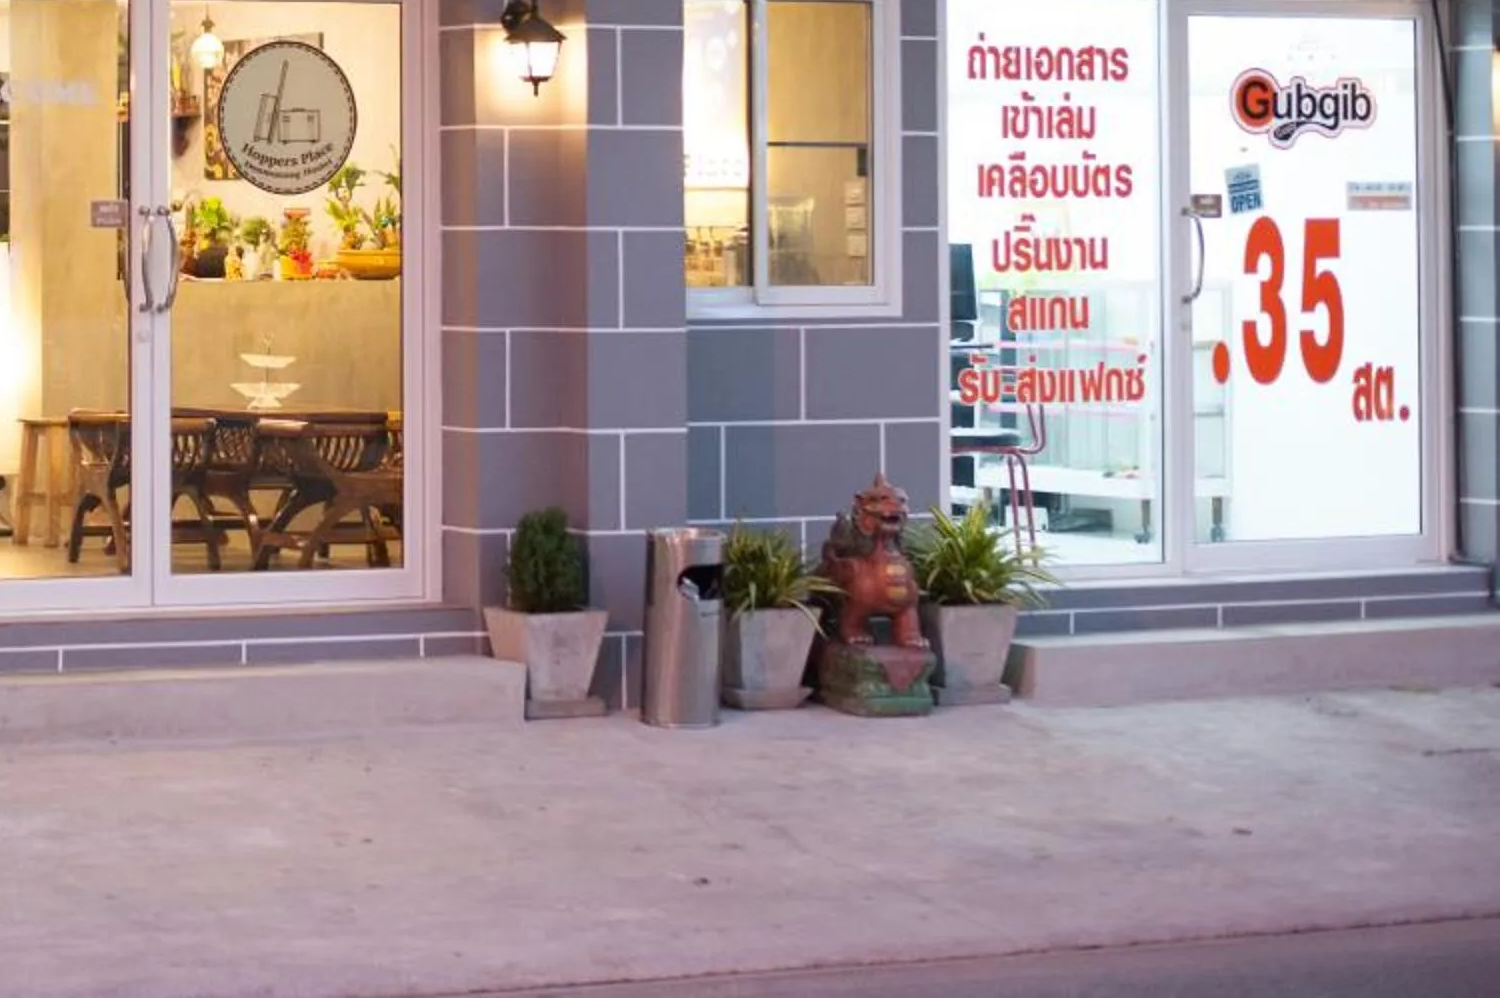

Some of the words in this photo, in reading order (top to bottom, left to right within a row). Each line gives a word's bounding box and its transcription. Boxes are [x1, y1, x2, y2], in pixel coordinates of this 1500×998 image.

[967, 32, 1129, 81] ถ่ายเอกสาร
[1002, 91, 1096, 139] เข้าเล่ม
[1242, 80, 1372, 130] Gubgib
[242, 142, 299, 168] Hoppers
[978, 150, 1133, 199] เคลือบบัตร
[1231, 192, 1262, 213] OPEN
[1008, 294, 1090, 332] สแกน
[1352, 362, 1411, 422] สต.
